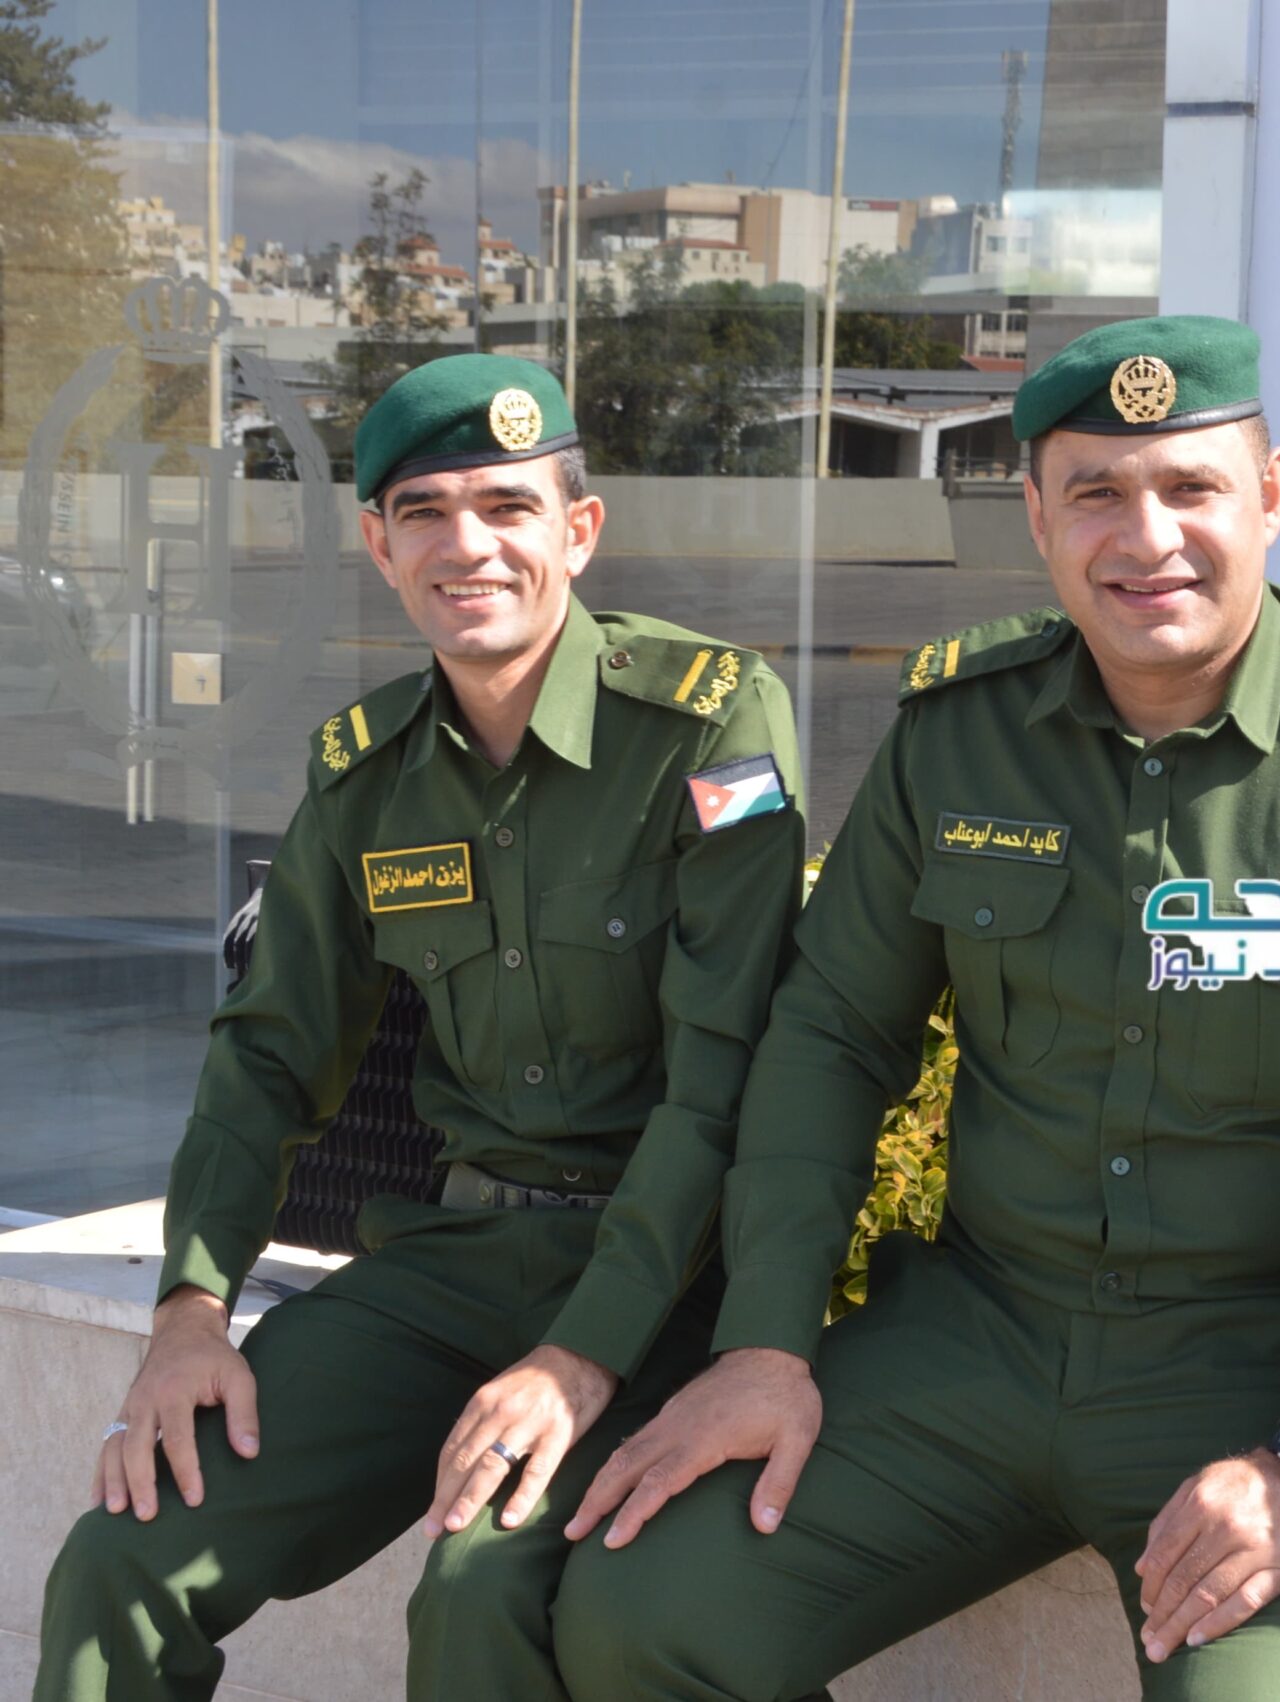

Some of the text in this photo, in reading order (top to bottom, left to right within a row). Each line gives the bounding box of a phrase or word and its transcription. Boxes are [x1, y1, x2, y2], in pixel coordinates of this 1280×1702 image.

[992, 827, 1031, 848] احمد
[1029, 829, 1061, 855] كايد
[404, 863, 434, 887] احمد
